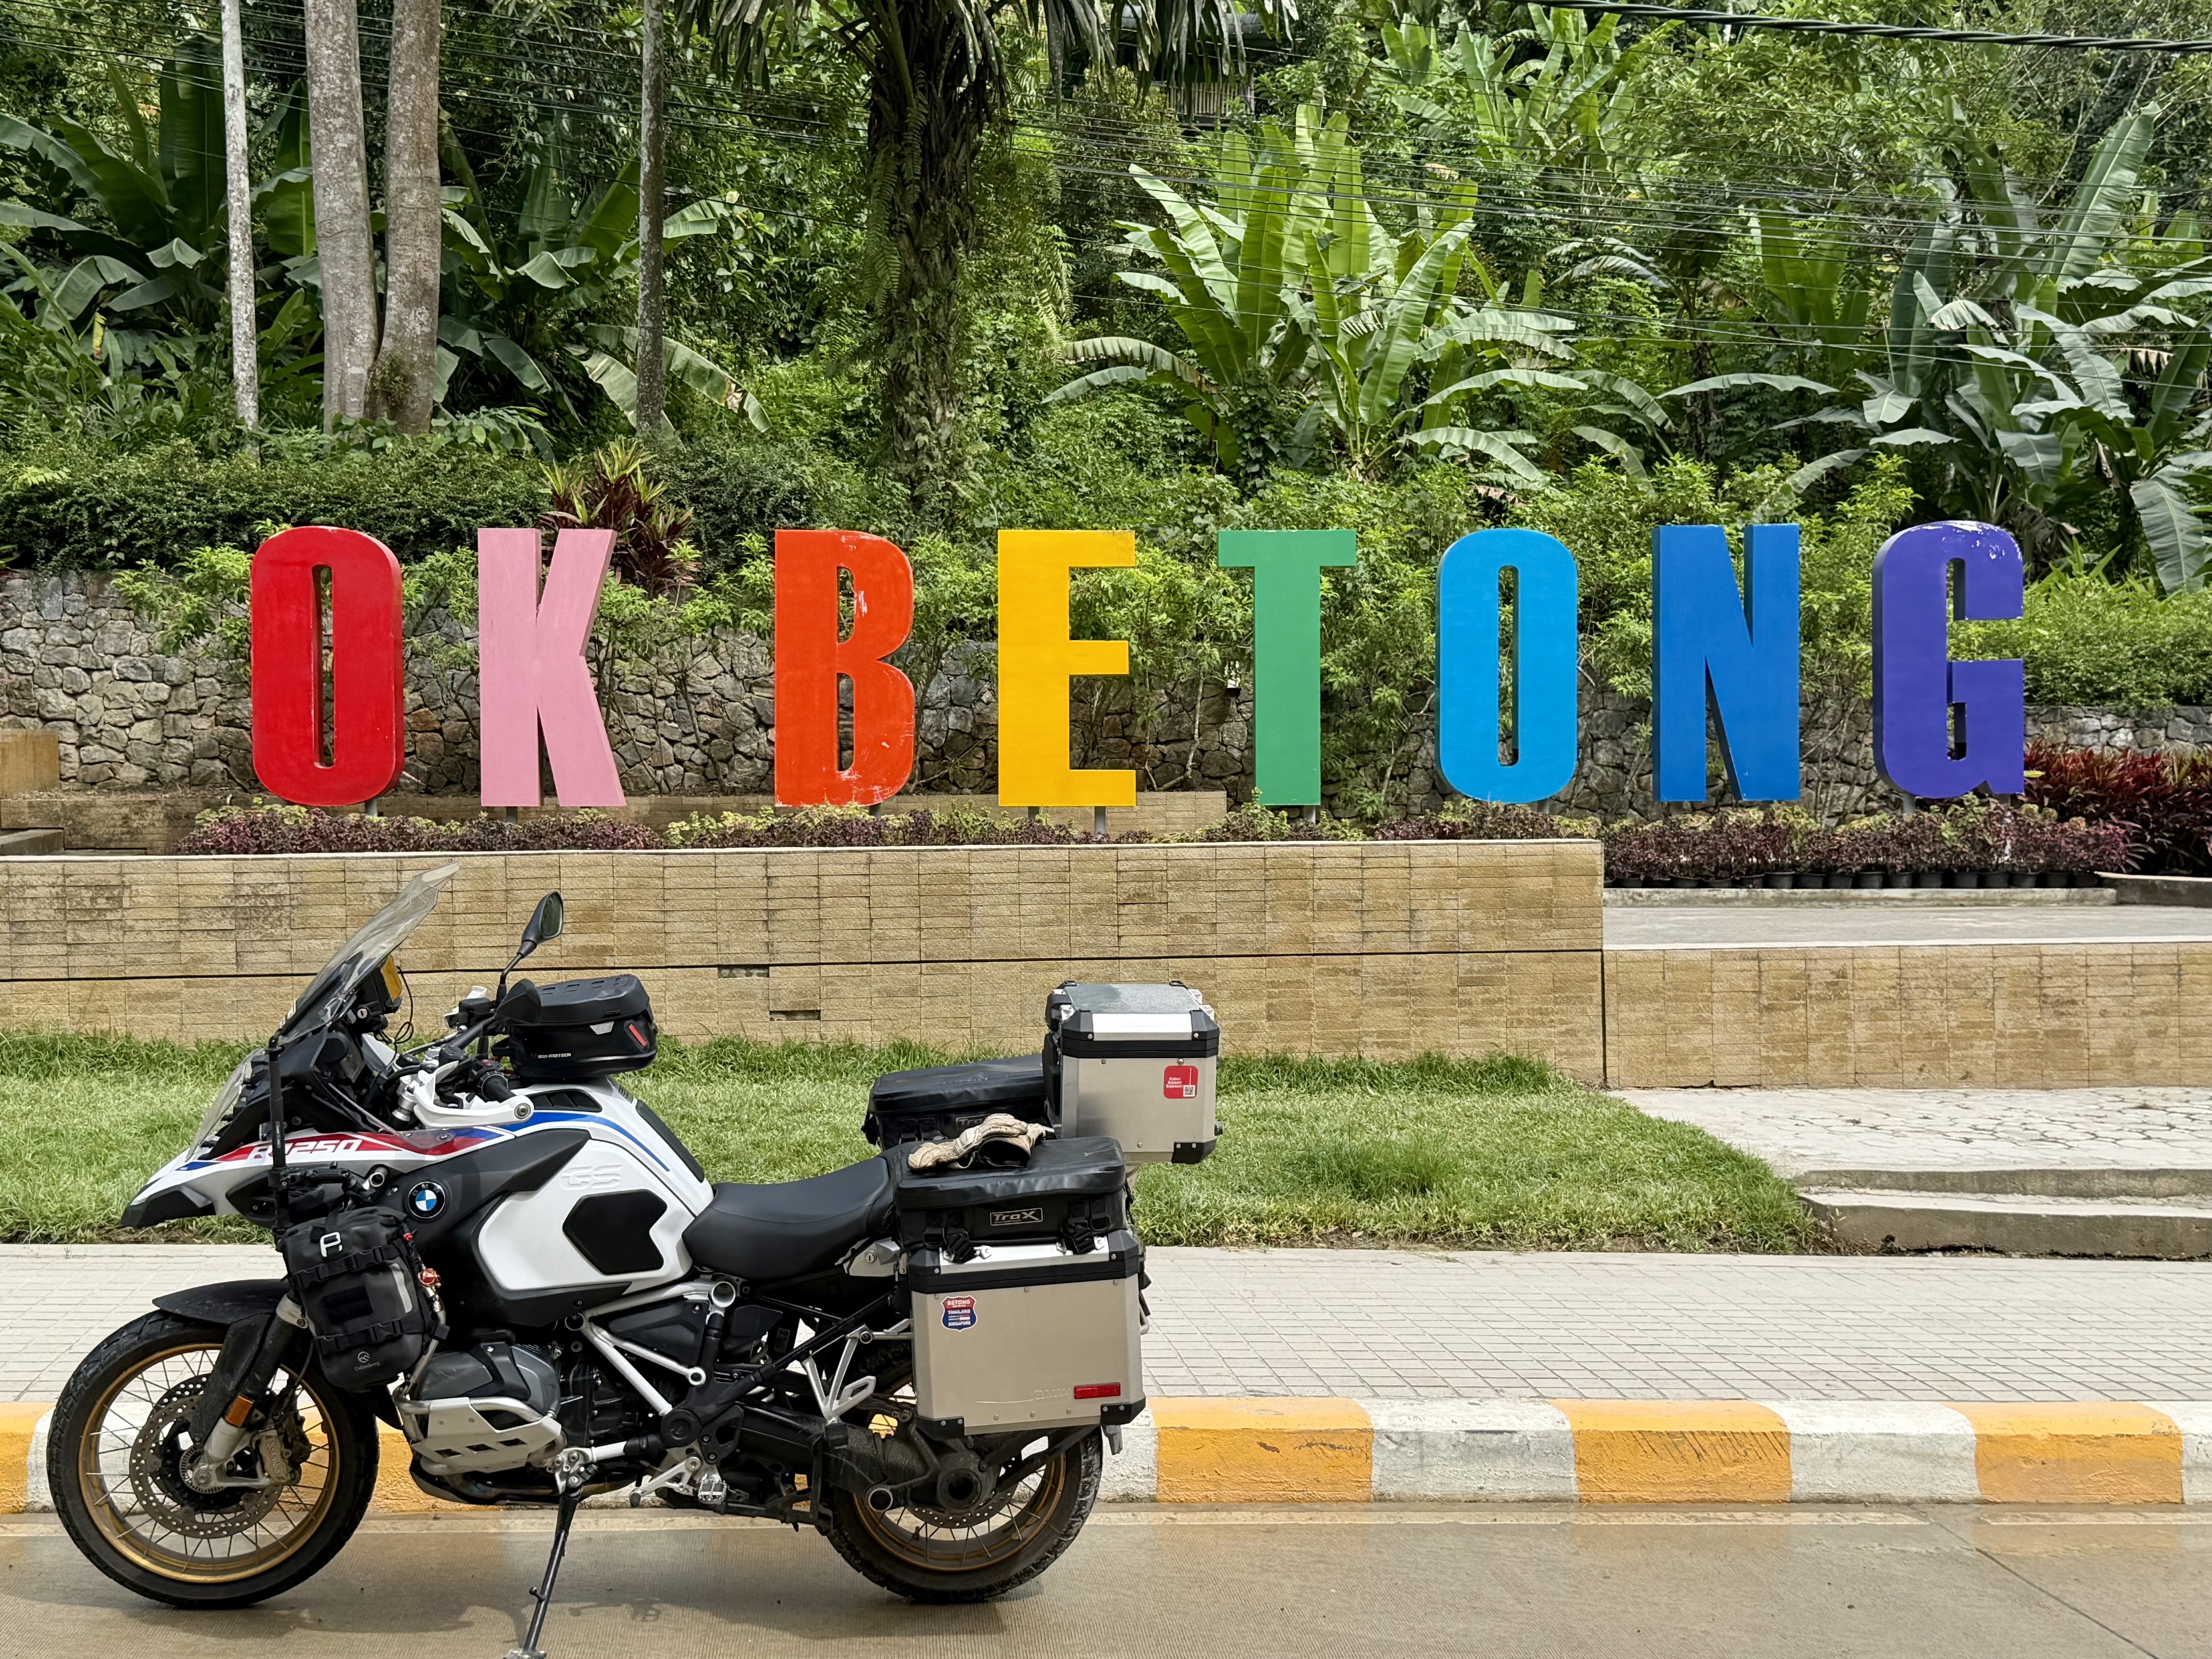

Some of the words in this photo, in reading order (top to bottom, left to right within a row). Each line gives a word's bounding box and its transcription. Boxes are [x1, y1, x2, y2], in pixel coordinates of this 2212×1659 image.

[251, 525, 626, 807] OK
[775, 520, 2025, 807] BETONG
[411, 1183, 441, 1196] BMW
[561, 1164, 623, 1190] GS
